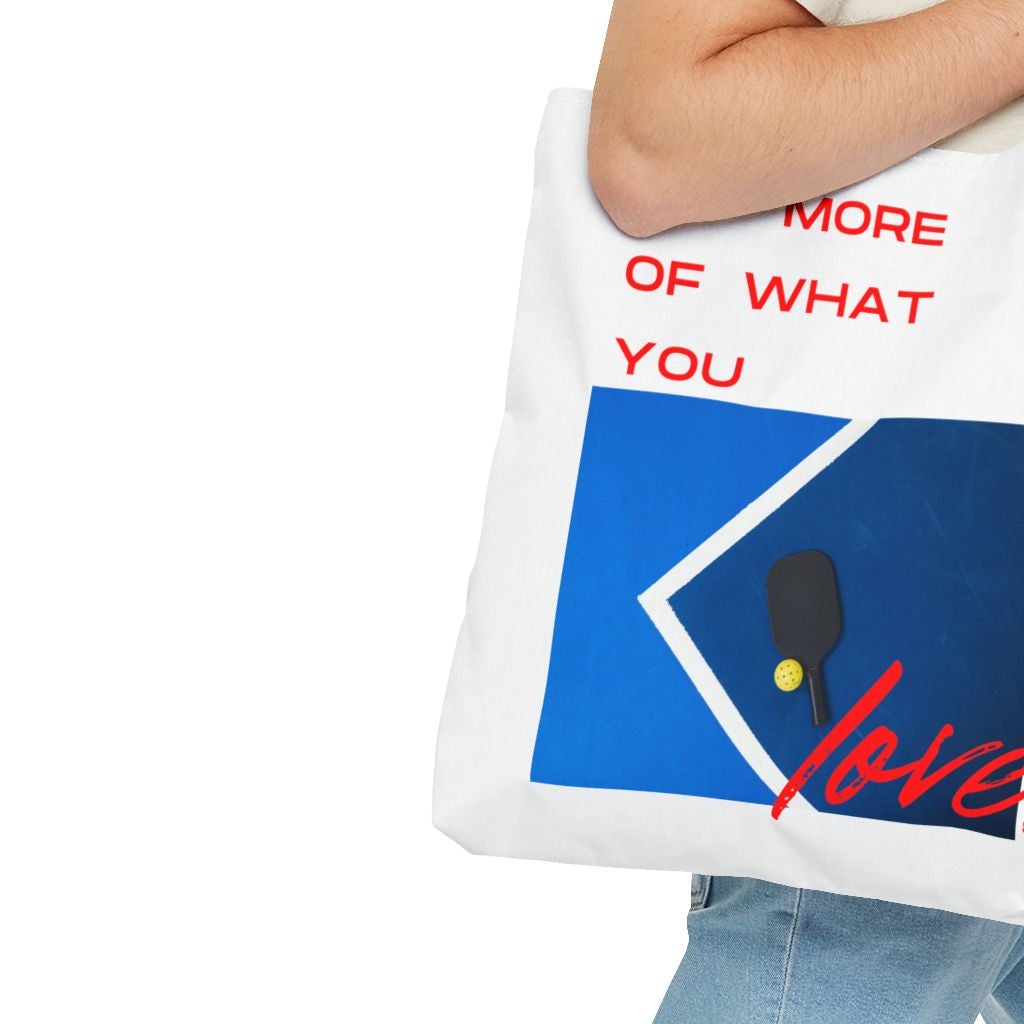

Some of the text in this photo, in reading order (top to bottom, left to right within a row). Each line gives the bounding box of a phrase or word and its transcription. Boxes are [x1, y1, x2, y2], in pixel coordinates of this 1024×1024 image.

[783, 197, 948, 247] MORE
[625, 255, 935, 324] OF WHAT
[615, 337, 745, 388] YOU
